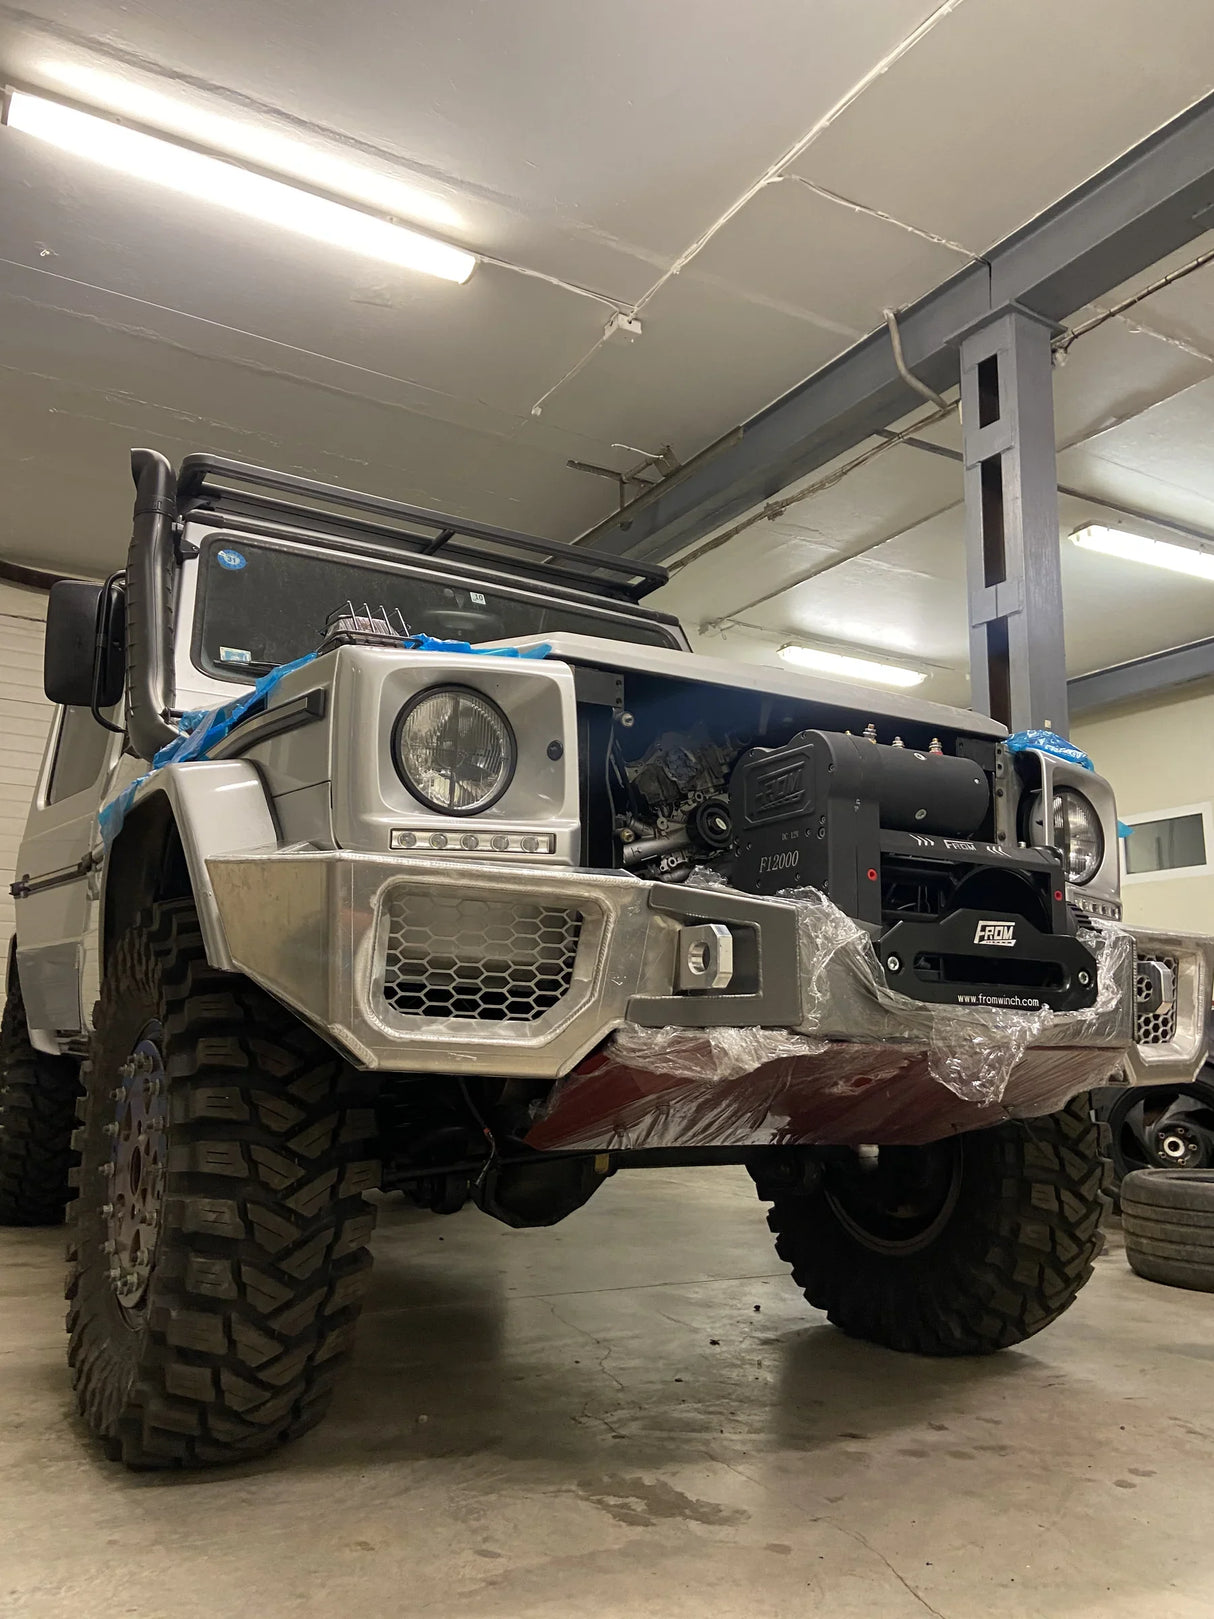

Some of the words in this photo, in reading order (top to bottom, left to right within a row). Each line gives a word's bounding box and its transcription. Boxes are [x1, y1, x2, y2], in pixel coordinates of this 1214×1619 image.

[943, 839, 977, 851] FROM
[759, 850, 799, 873] F12000
[973, 920, 1016, 944] FROM
[957, 993, 1040, 1007] www.fromwinch.com
